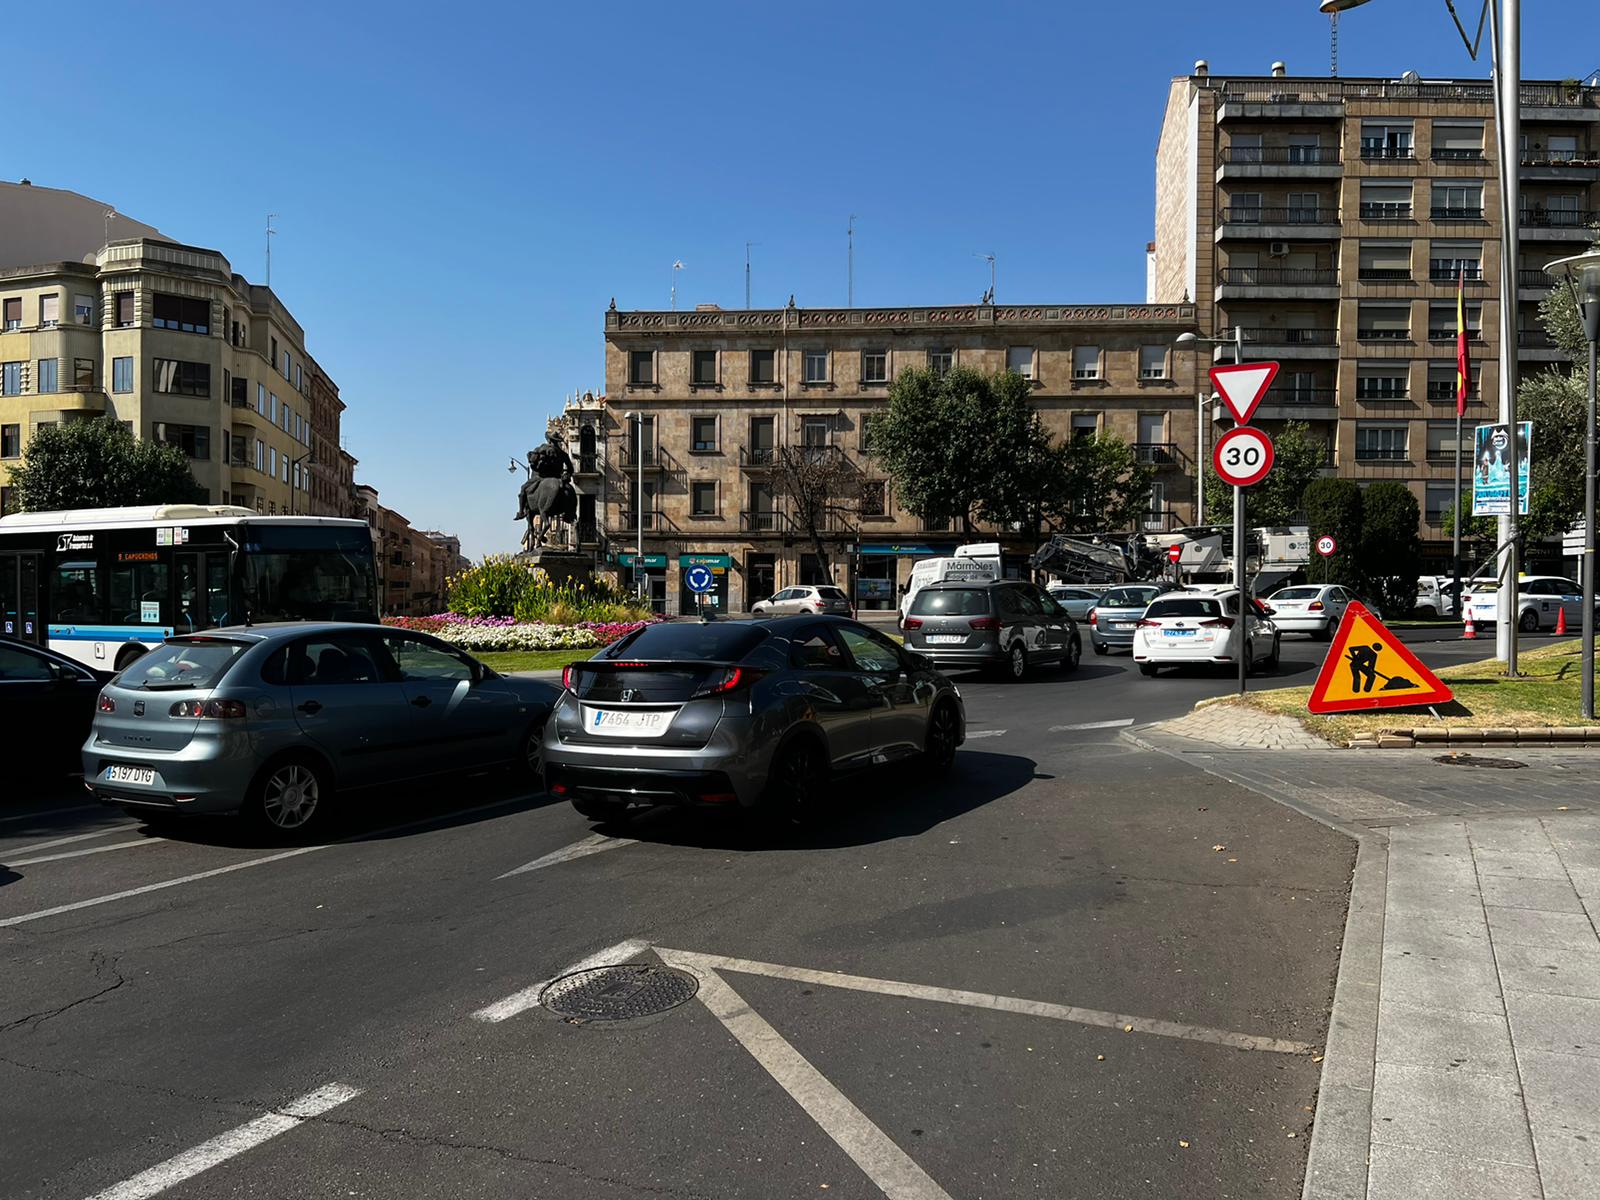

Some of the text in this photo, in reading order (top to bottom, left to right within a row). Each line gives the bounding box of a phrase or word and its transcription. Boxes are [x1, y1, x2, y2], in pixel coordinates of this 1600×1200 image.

[1226, 447, 1259, 466] 30
[1320, 541, 1332, 549] 30
[946, 561, 993, 570] Mármoles
[601, 712, 661, 727] 7464 JTP
[111, 766, 151, 782] 5197 DYG
